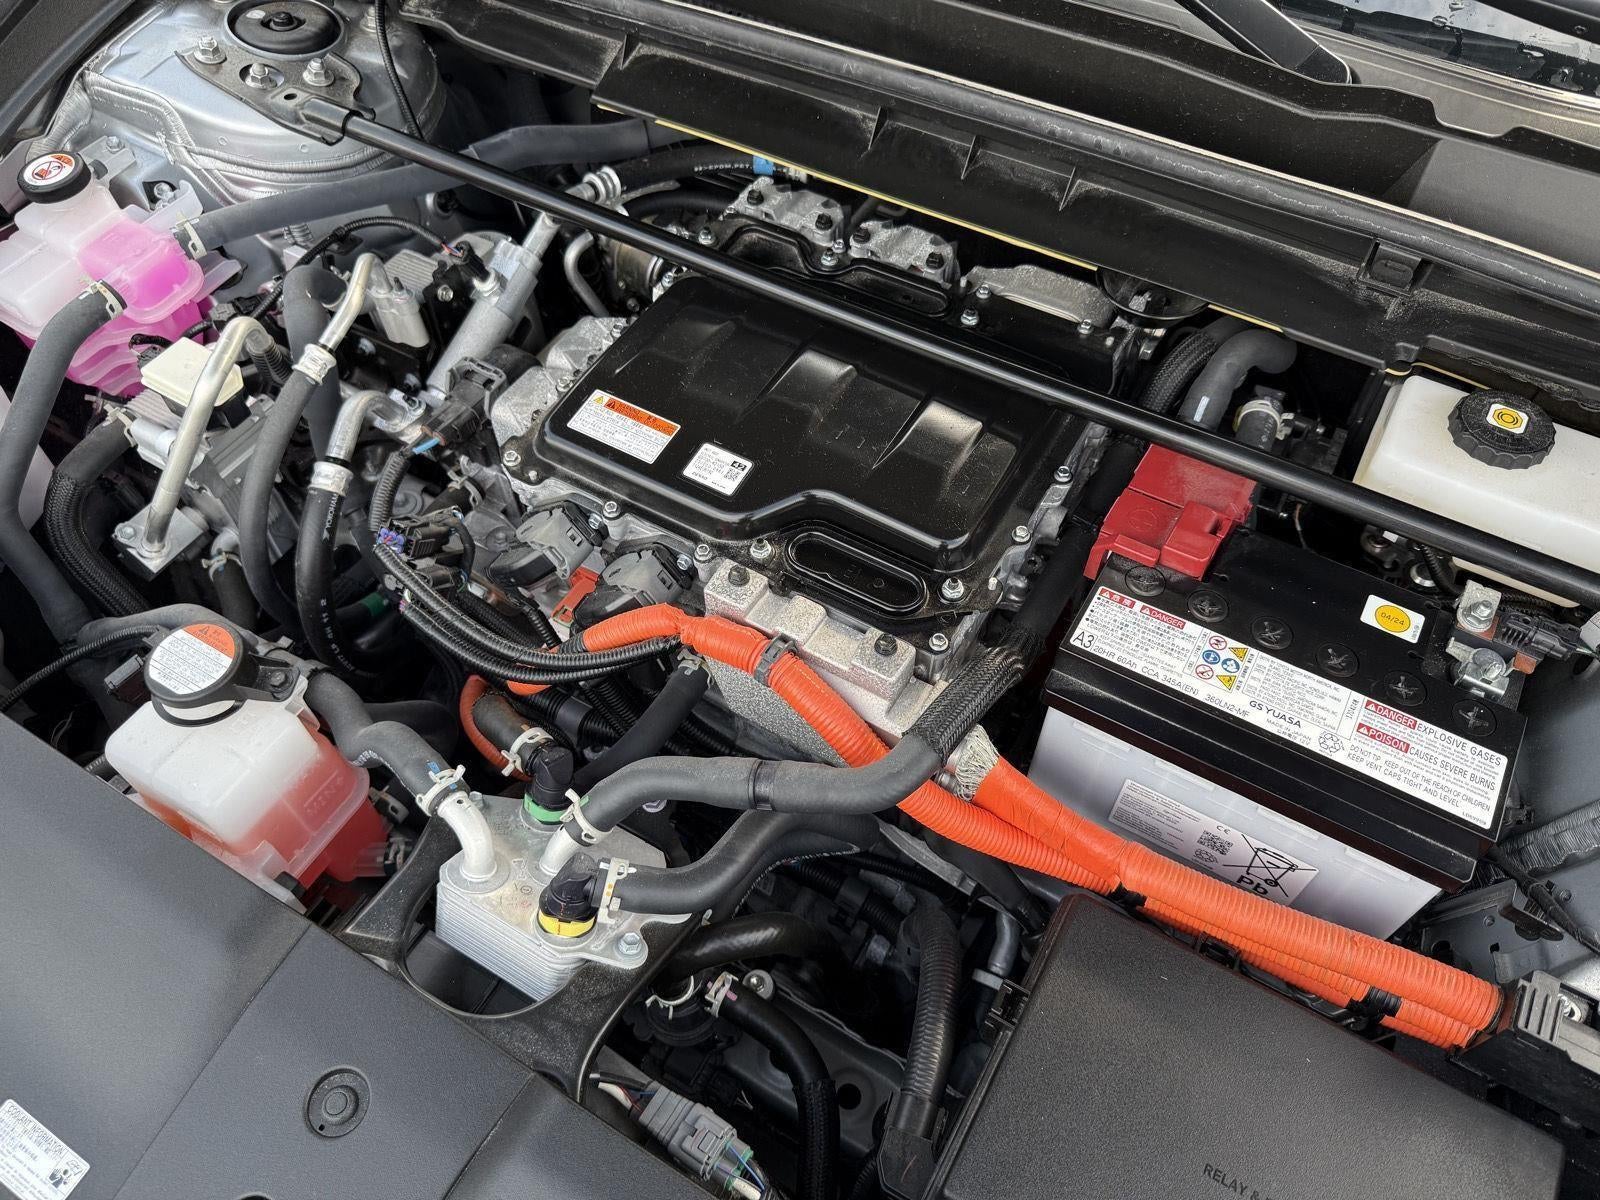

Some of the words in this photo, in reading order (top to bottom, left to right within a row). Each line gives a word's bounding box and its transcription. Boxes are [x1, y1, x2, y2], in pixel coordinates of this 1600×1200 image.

[733, 460, 747, 472] 42
[325, 493, 338, 529] YOKOHAM
[1149, 609, 1185, 629] DANGER
[1380, 612, 1405, 626] 04/24
[1071, 629, 1096, 649] A3
[1091, 644, 1116, 660] 20HR
[1115, 654, 1139, 669] 60Ah
[1139, 665, 1161, 679] CCA
[1160, 674, 1200, 696] 345A(EN)
[1248, 699, 1264, 711] GS
[1263, 705, 1303, 728] YUASA
[1265, 717, 1284, 729] MADE
[1290, 729, 1312, 741] JAPAN
[1374, 704, 1416, 729] DANGER
[1415, 722, 1468, 752] EXPLOSIVE
[1468, 745, 1502, 767] GASES
[1367, 727, 1408, 752] POISON
[1407, 745, 1439, 766] CAUSES
[1438, 758, 1469, 779] SEVERE
[1468, 772, 1496, 791] BURNS
[1346, 751, 1364, 765] KEEP
[1363, 759, 1382, 773] VENT
[1382, 767, 1402, 782] CAPS
[1401, 776, 1422, 791] TIGHT
[1420, 785, 1438, 798] AND
[1438, 792, 1461, 808] LEVEL
[1349, 744, 1360, 753] DO
[1358, 748, 1372, 758] NOT
[1383, 759, 1399, 771] KEEP
[1398, 765, 1411, 776] OUT
[1410, 771, 1420, 780] OF
[1419, 775, 1432, 786] THE
[1431, 780, 1453, 795] REACH
[1451, 789, 1461, 799] OF
[1460, 793, 1491, 812] CHILDREN
[1236, 875, 1269, 896] Pb
[7, 1105, 32, 1127] COOLANT
[30, 1125, 64, 1156] INFORMATION
[1203, 1163, 1248, 1195] RELAY
